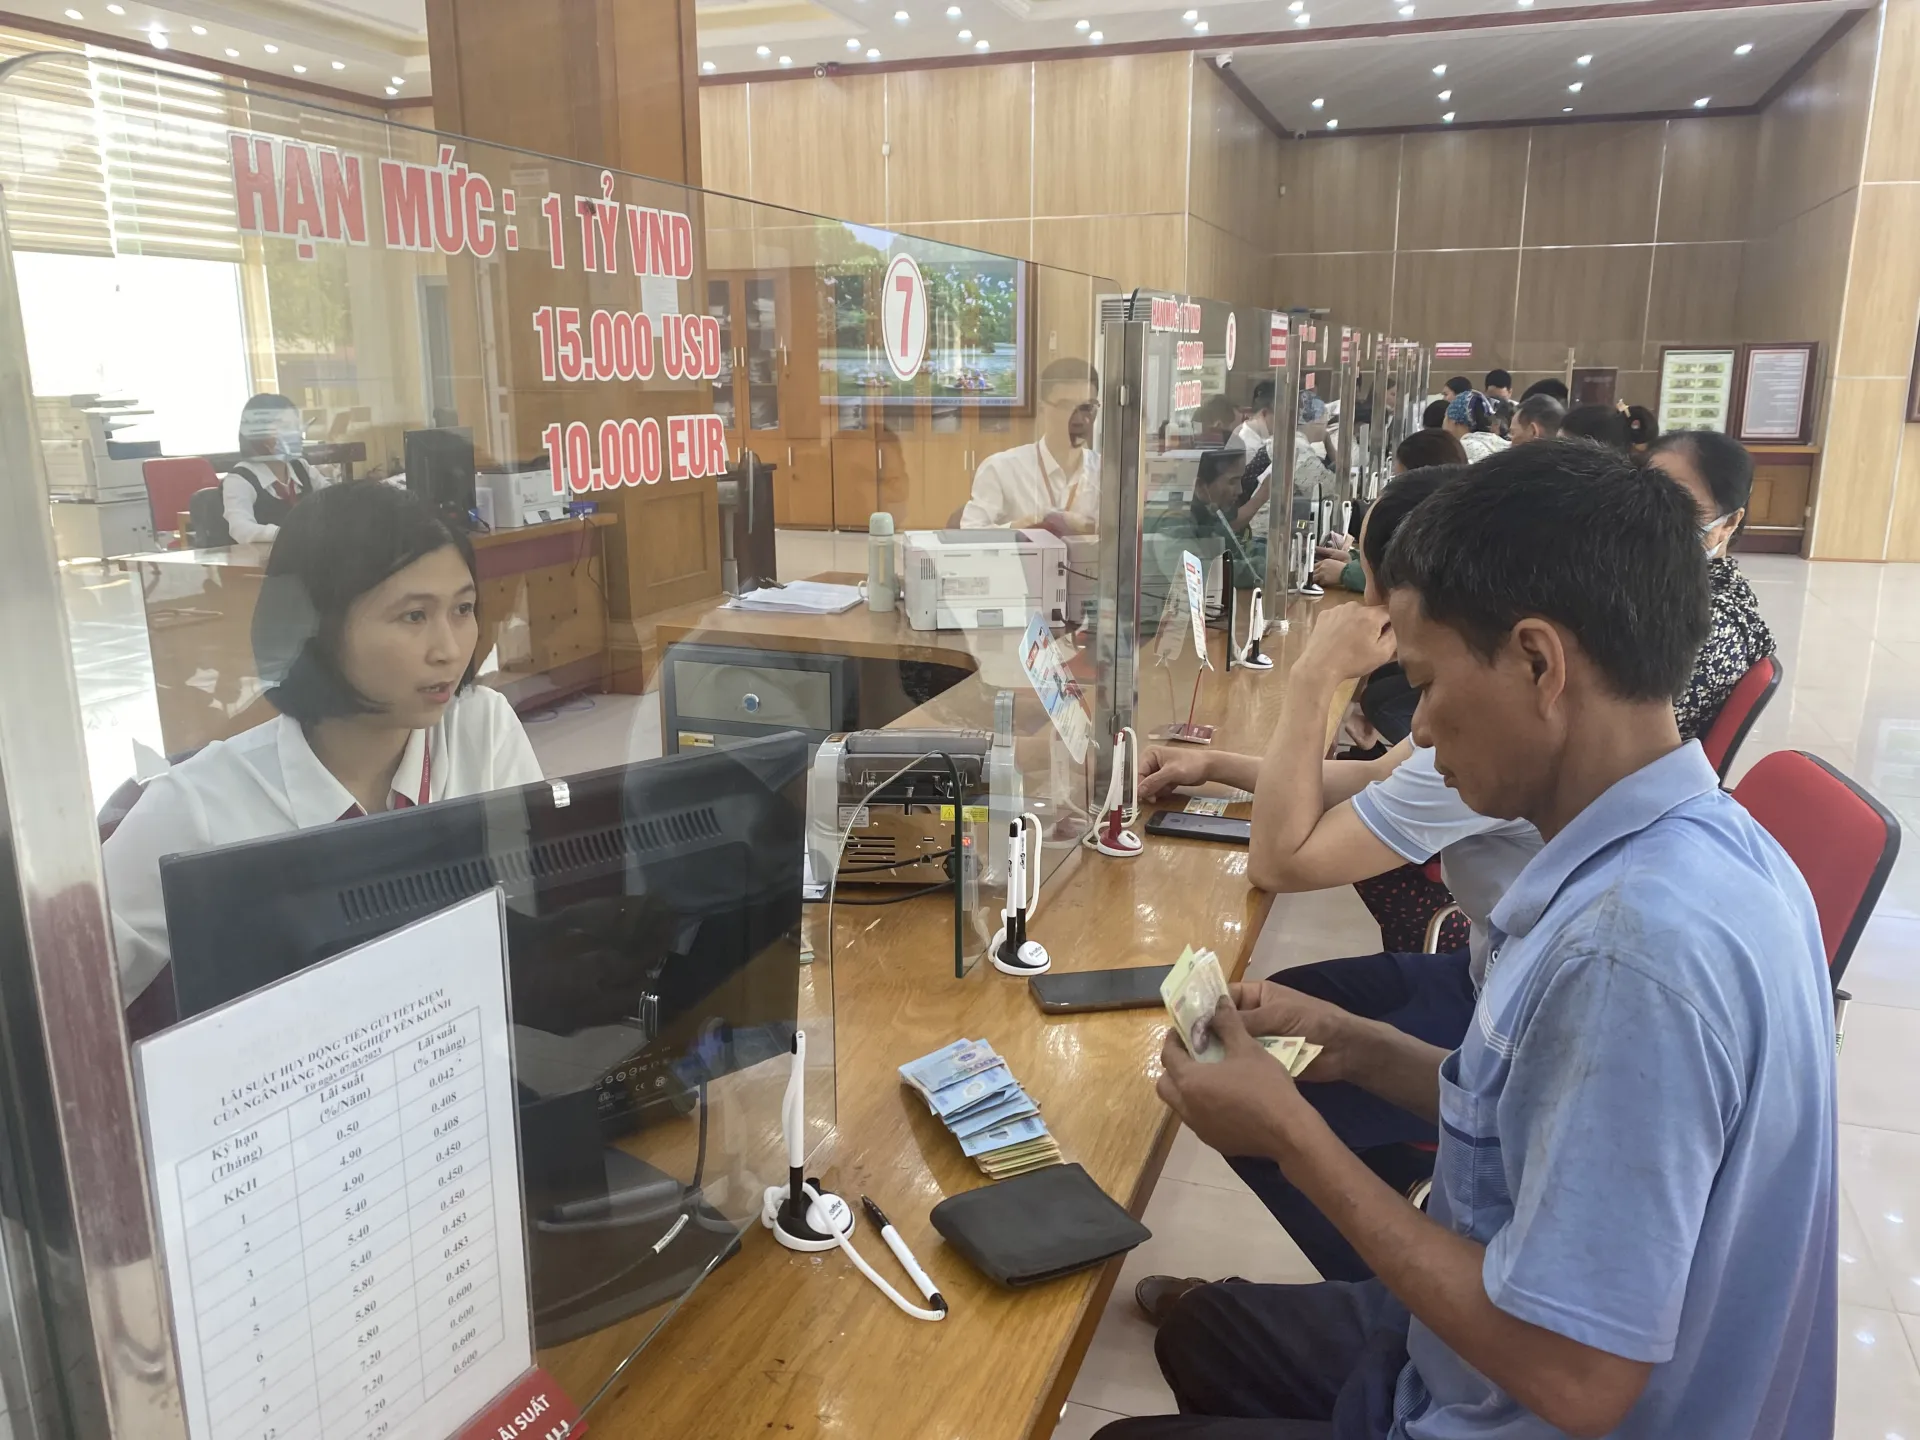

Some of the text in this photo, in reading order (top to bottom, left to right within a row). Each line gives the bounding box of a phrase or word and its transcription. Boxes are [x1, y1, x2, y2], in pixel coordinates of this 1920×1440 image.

[228, 130, 369, 261] HẠN
[542, 192, 565, 270] 1
[574, 169, 619, 274] TỶ
[626, 204, 694, 280] VND
[895, 275, 914, 358] 7
[533, 306, 721, 382] 15.000 USD
[542, 413, 728, 496] 10.000 EUR
[417, 1021, 457, 1051] Lãi suất
[244, 1087, 277, 1109] NGÂN
[281, 1068, 315, 1092] HÀNG
[317, 1049, 349, 1071] NÔNG
[352, 1029, 391, 1054] NGHIỆP
[393, 1017, 415, 1034] YÊN
[416, 998, 452, 1023] KHÁNH
[413, 1035, 467, 1073] (% Tháng)
[221, 1088, 243, 1107] LÃI
[280, 1057, 305, 1077] HUY
[320, 1070, 365, 1104] Lãi suất
[429, 1067, 455, 1089] 0.042
[320, 1087, 371, 1124] (%/Năm)
[431, 1091, 457, 1114] 0.408
[336, 1120, 359, 1141] 0.50
[433, 1115, 459, 1138] 0.408
[234, 1130, 258, 1150] hạn
[435, 1140, 461, 1163] 0.450
[211, 1146, 263, 1183] (Tháng)
[339, 1147, 362, 1166] 4.90
[342, 1172, 365, 1193] 4.90
[438, 1164, 463, 1187] 0.450
[223, 1178, 257, 1205] KKH
[440, 1188, 466, 1212] 0.450
[345, 1198, 367, 1220] 5.40
[347, 1224, 370, 1246] 5.40
[442, 1212, 468, 1235] 0.483
[444, 1235, 469, 1259] 0.483
[350, 1250, 372, 1271] 5.40
[446, 1259, 471, 1283] 0.483
[352, 1275, 374, 1298] 5.80
[448, 1282, 473, 1306] 0.600
[355, 1300, 377, 1323] 5.80
[450, 1304, 475, 1329] 0.600
[357, 1325, 379, 1347] 5.80
[452, 1328, 477, 1352] 0.600
[360, 1350, 381, 1372] 7.20
[453, 1349, 478, 1375] 0.600
[362, 1373, 384, 1396] 7.20
[364, 1398, 386, 1421] 7.20
[514, 1393, 551, 1431] SUẤT
